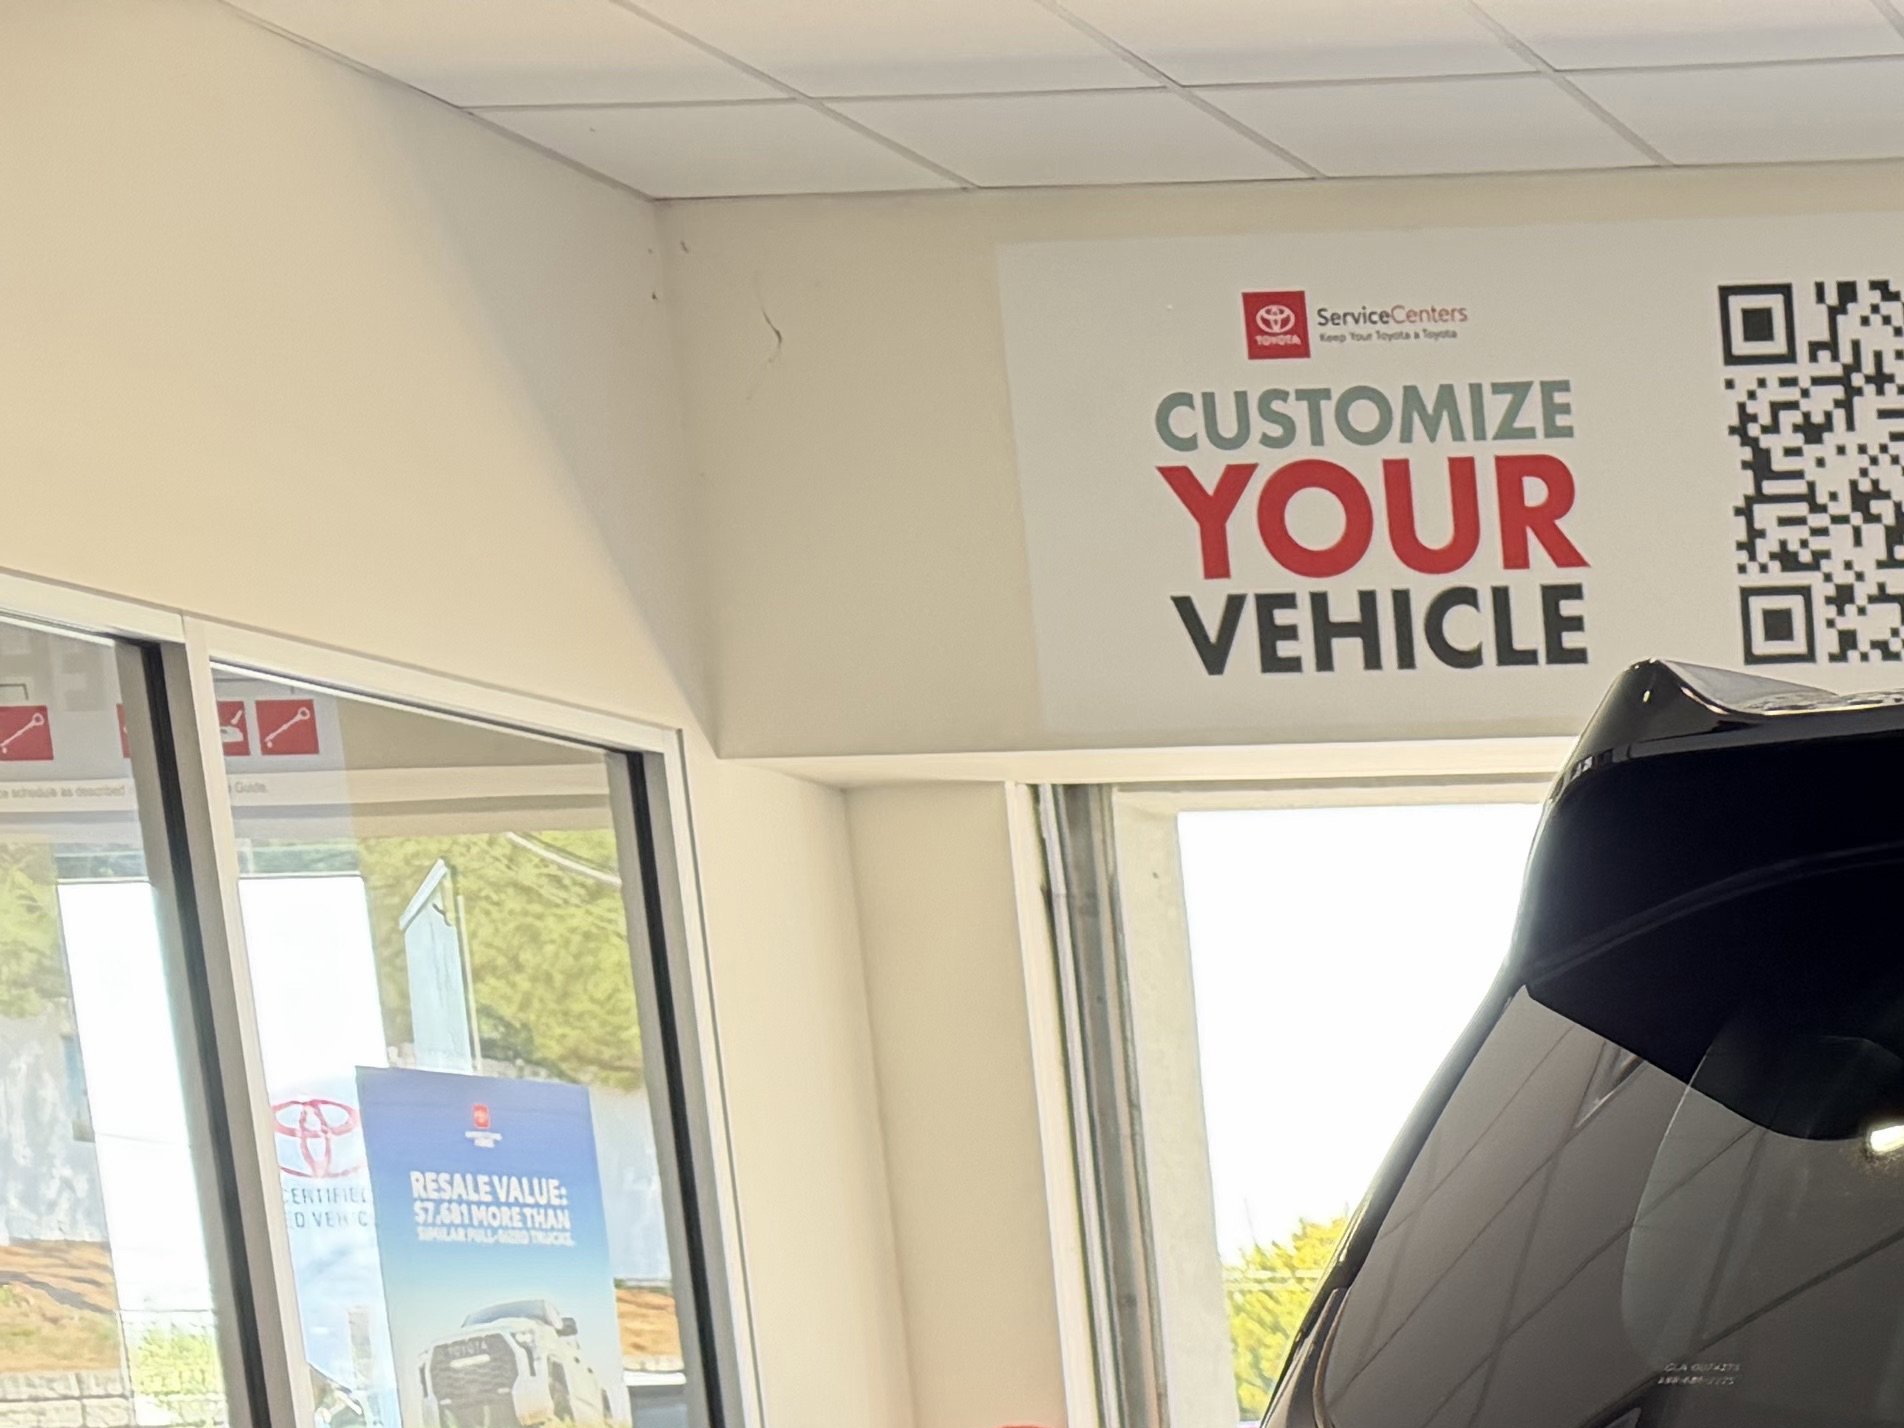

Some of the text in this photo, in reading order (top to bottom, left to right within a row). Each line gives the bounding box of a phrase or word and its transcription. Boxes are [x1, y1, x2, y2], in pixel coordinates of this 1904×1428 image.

[1316, 304, 1469, 327] ServiceCenters
[1255, 334, 1302, 346] TOYOTA
[1376, 330, 1411, 342] Toyota
[1422, 328, 1458, 341] Toyota
[1154, 379, 1575, 452] CUSTOMIZE
[1155, 452, 1593, 581] YOUR
[1169, 582, 1590, 676] VEHICLE
[409, 1170, 568, 1207] RESALE VALUE:
[472, 1204, 522, 1229] MORE
[523, 1207, 571, 1231] THAN
